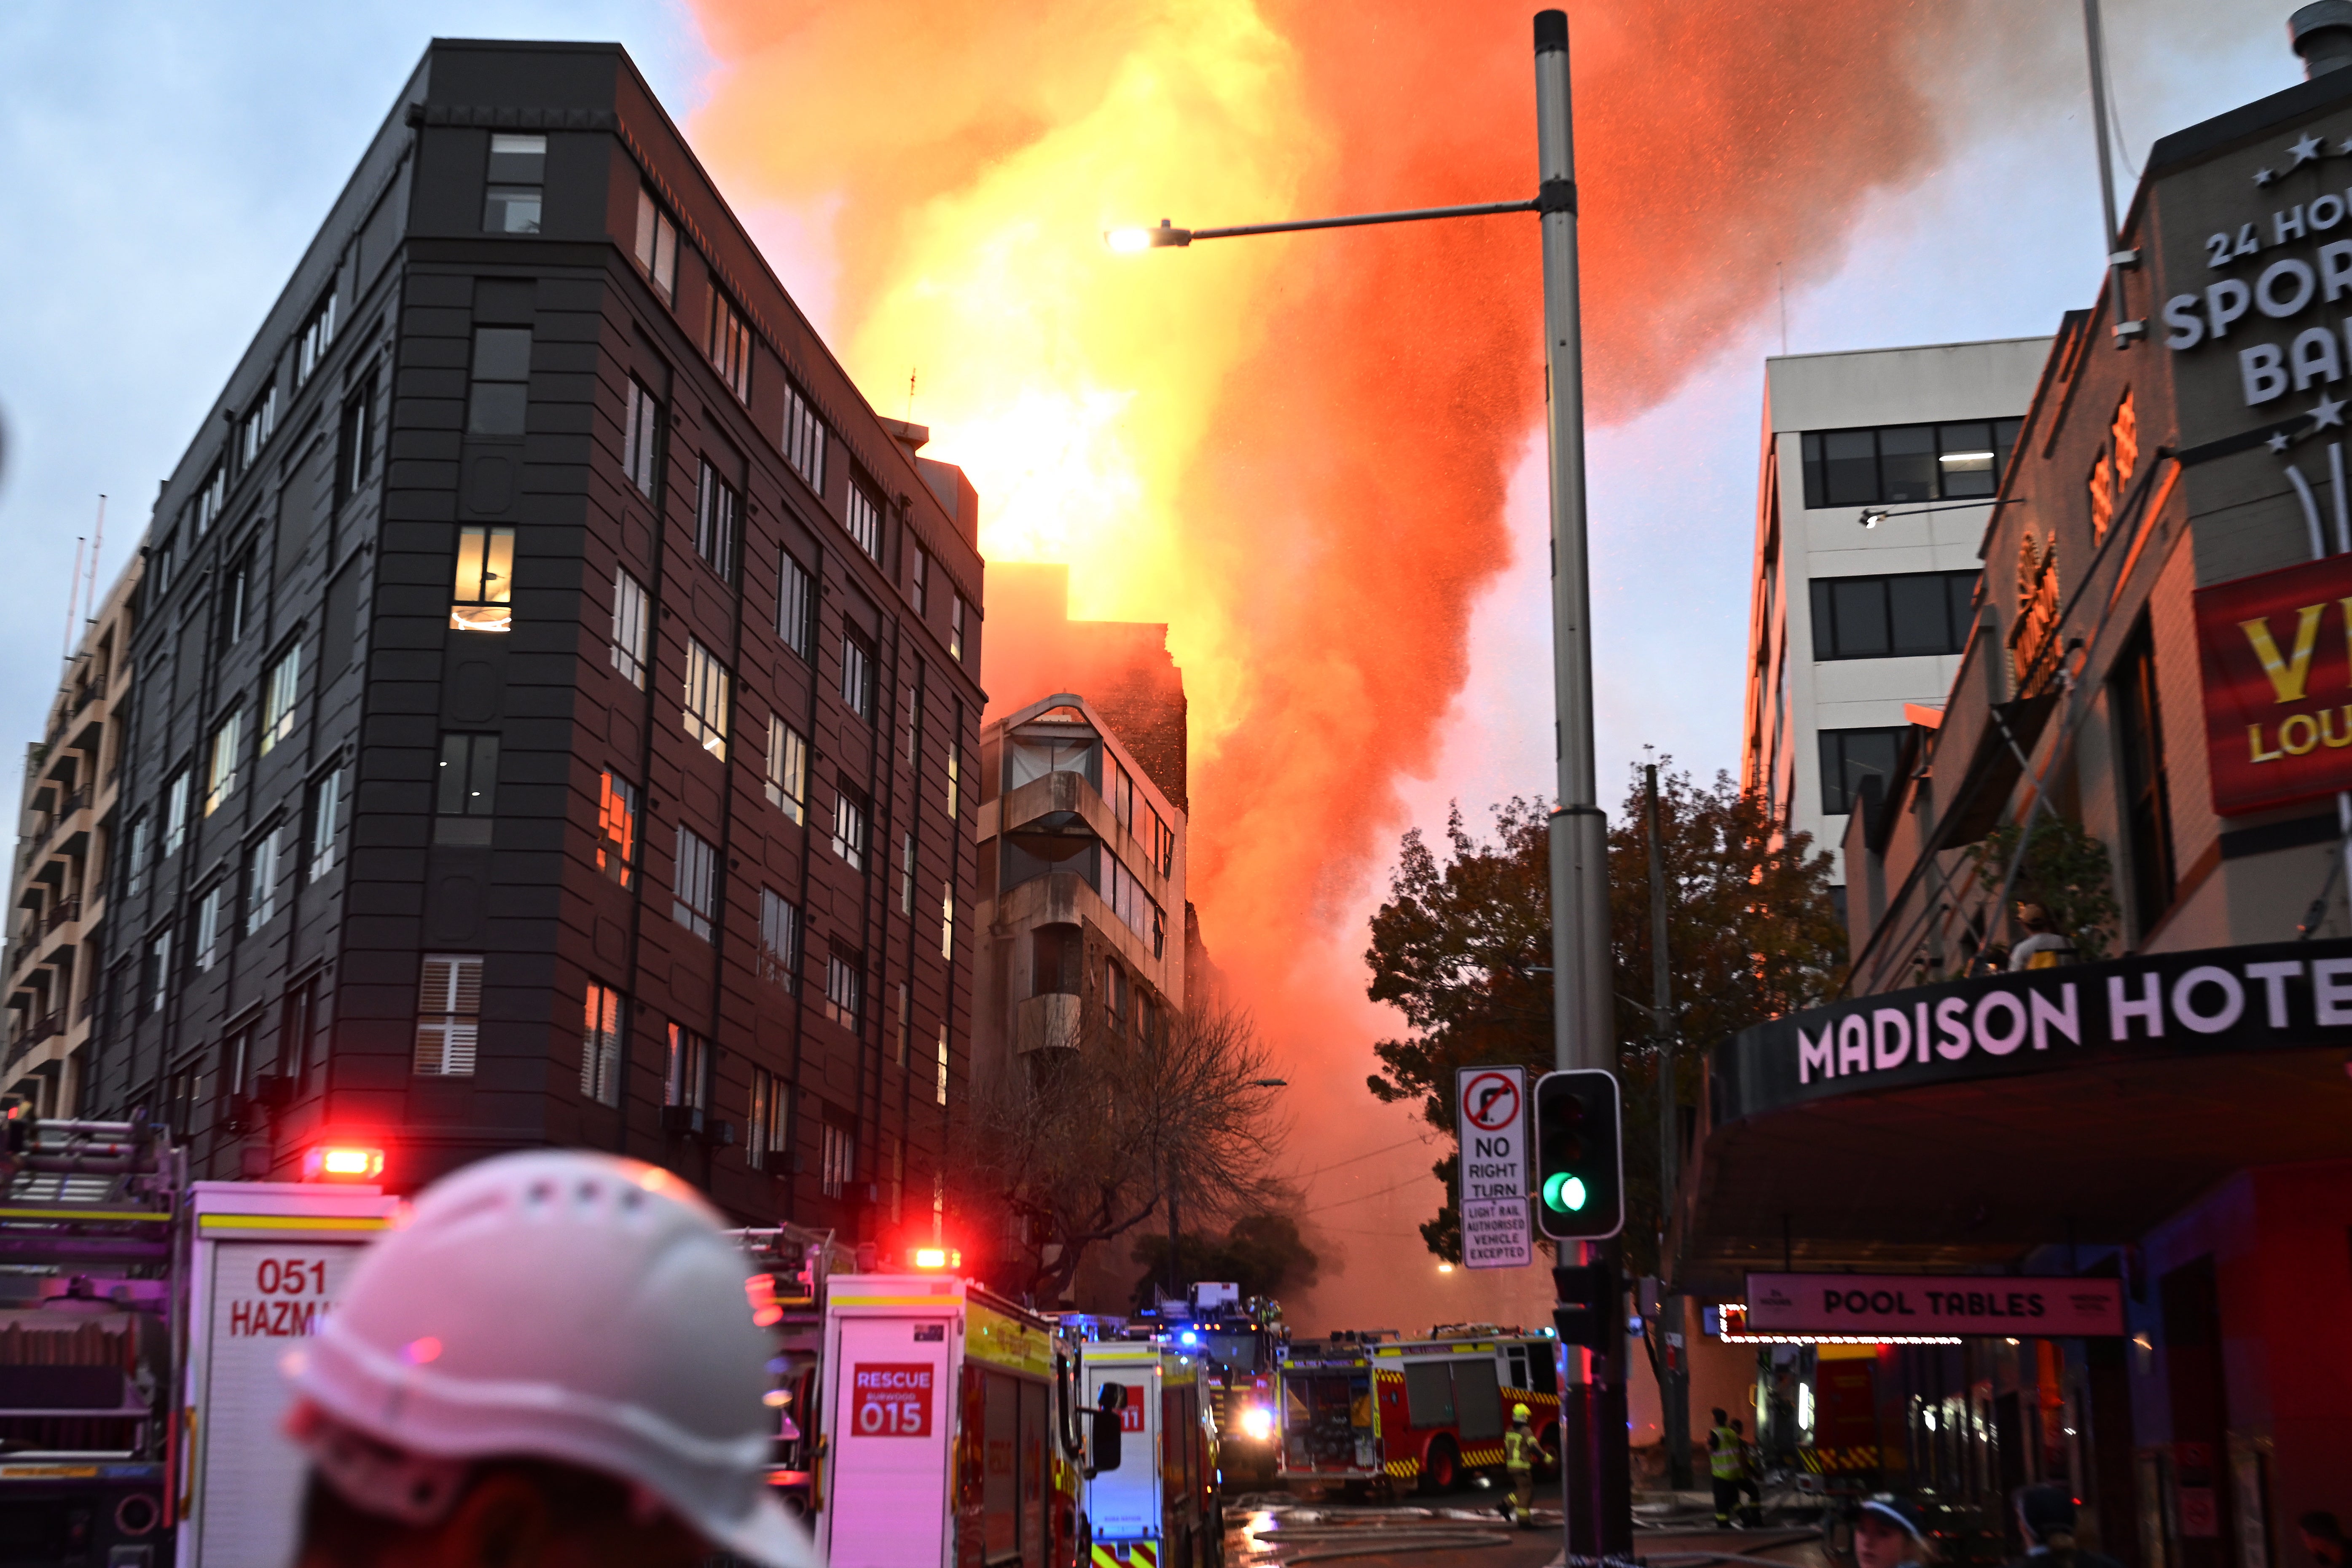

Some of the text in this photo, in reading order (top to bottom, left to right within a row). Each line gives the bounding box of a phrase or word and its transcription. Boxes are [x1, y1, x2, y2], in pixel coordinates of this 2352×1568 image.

[2206, 222, 2259, 268] 24
[2239, 316, 2352, 406] BA
[1798, 957, 2352, 1084] MADISON HOTE
[1476, 1137, 1509, 1158] NO
[1469, 1163, 1517, 1178] RIGHT
[1472, 1184, 1517, 1198] TURN
[1469, 1206, 1495, 1218] LIGHT
[1474, 1233, 1519, 1246] VEHICLE
[1470, 1246, 1525, 1260] EXCEPTED
[258, 1258, 325, 1295] 051
[1823, 1289, 2045, 1317] POOL TABLES
[231, 1300, 330, 1337] HAZM
[857, 1371, 931, 1388] RESCUE
[860, 1402, 922, 1432] 015
[1121, 1411, 1138, 1428] 11
